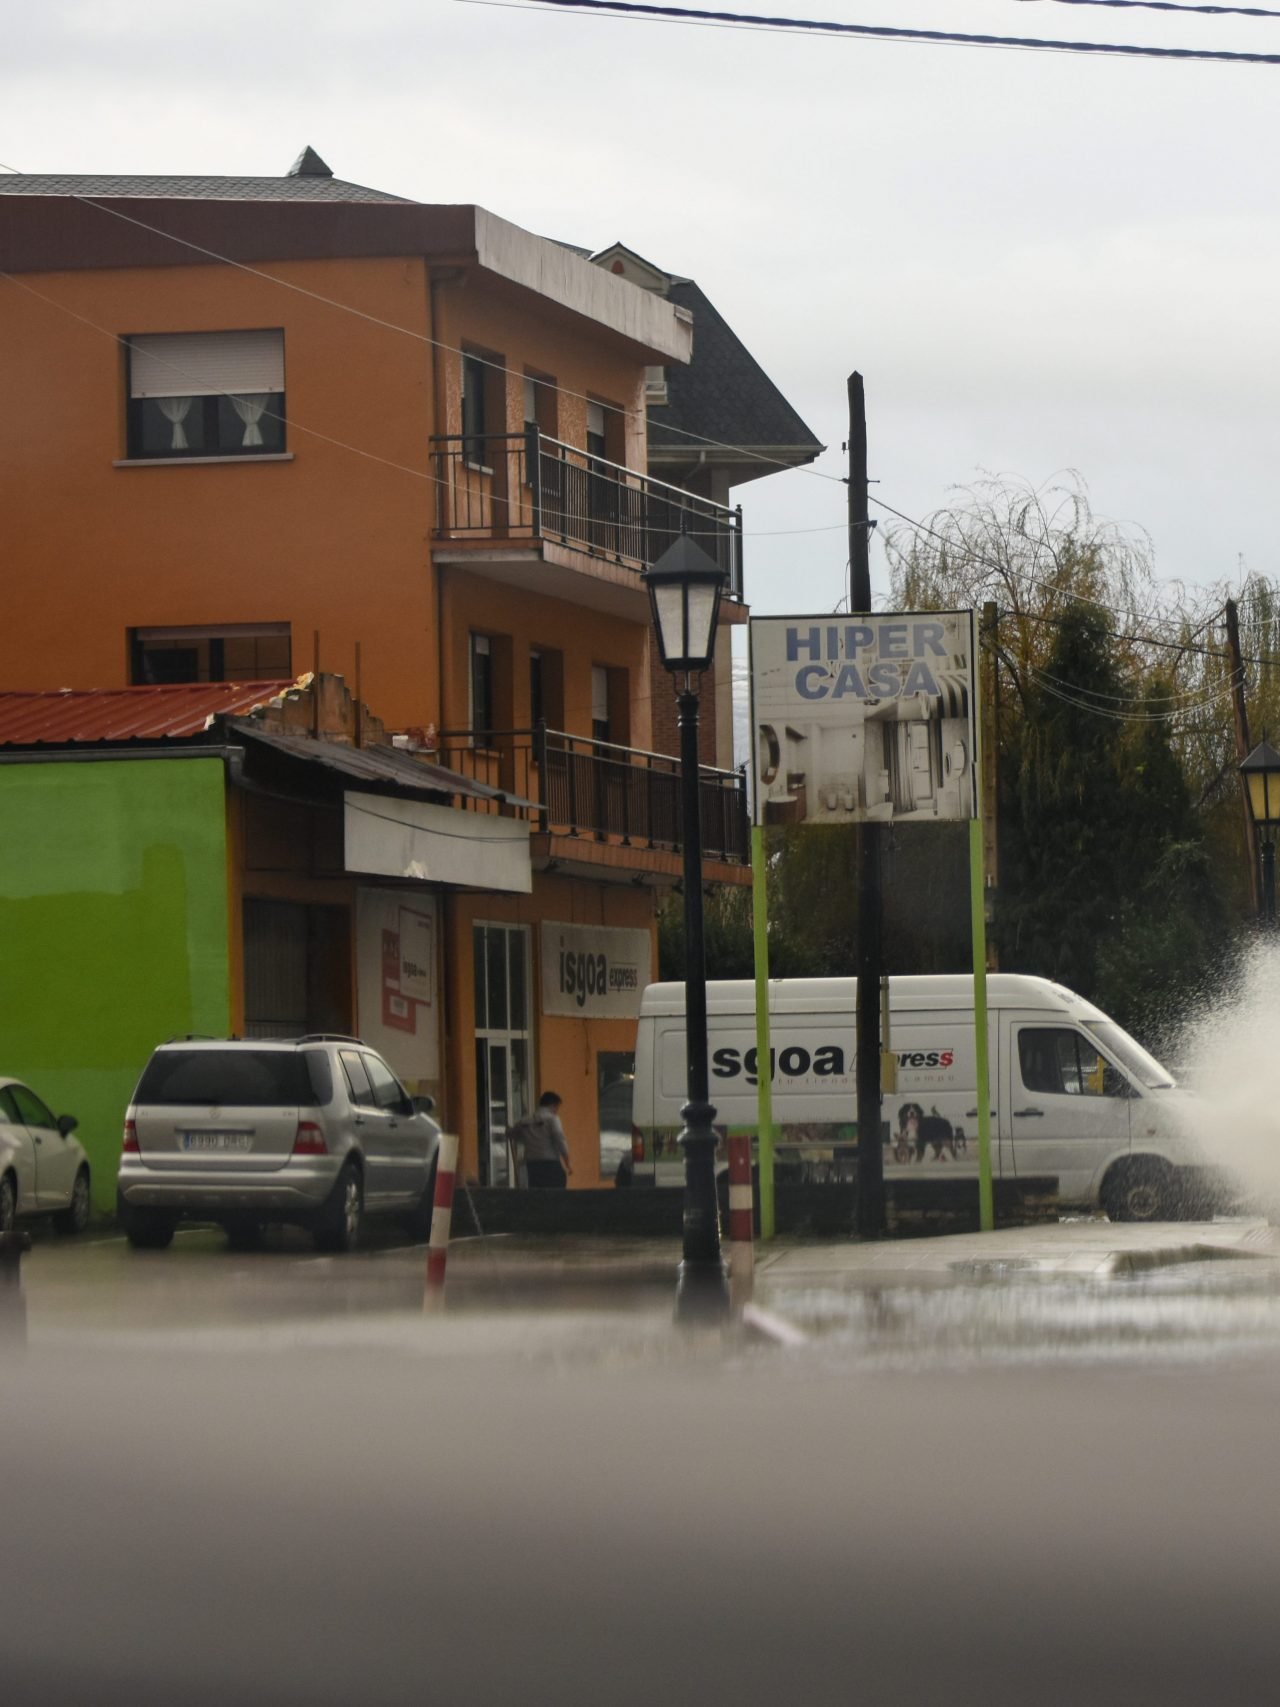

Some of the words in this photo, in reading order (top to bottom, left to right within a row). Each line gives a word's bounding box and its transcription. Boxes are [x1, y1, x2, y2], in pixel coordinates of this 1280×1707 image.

[786, 622, 948, 662] HIPER
[795, 663, 940, 699] CASA
[560, 935, 607, 1008] isgoa
[712, 1046, 845, 1086] sgoa
